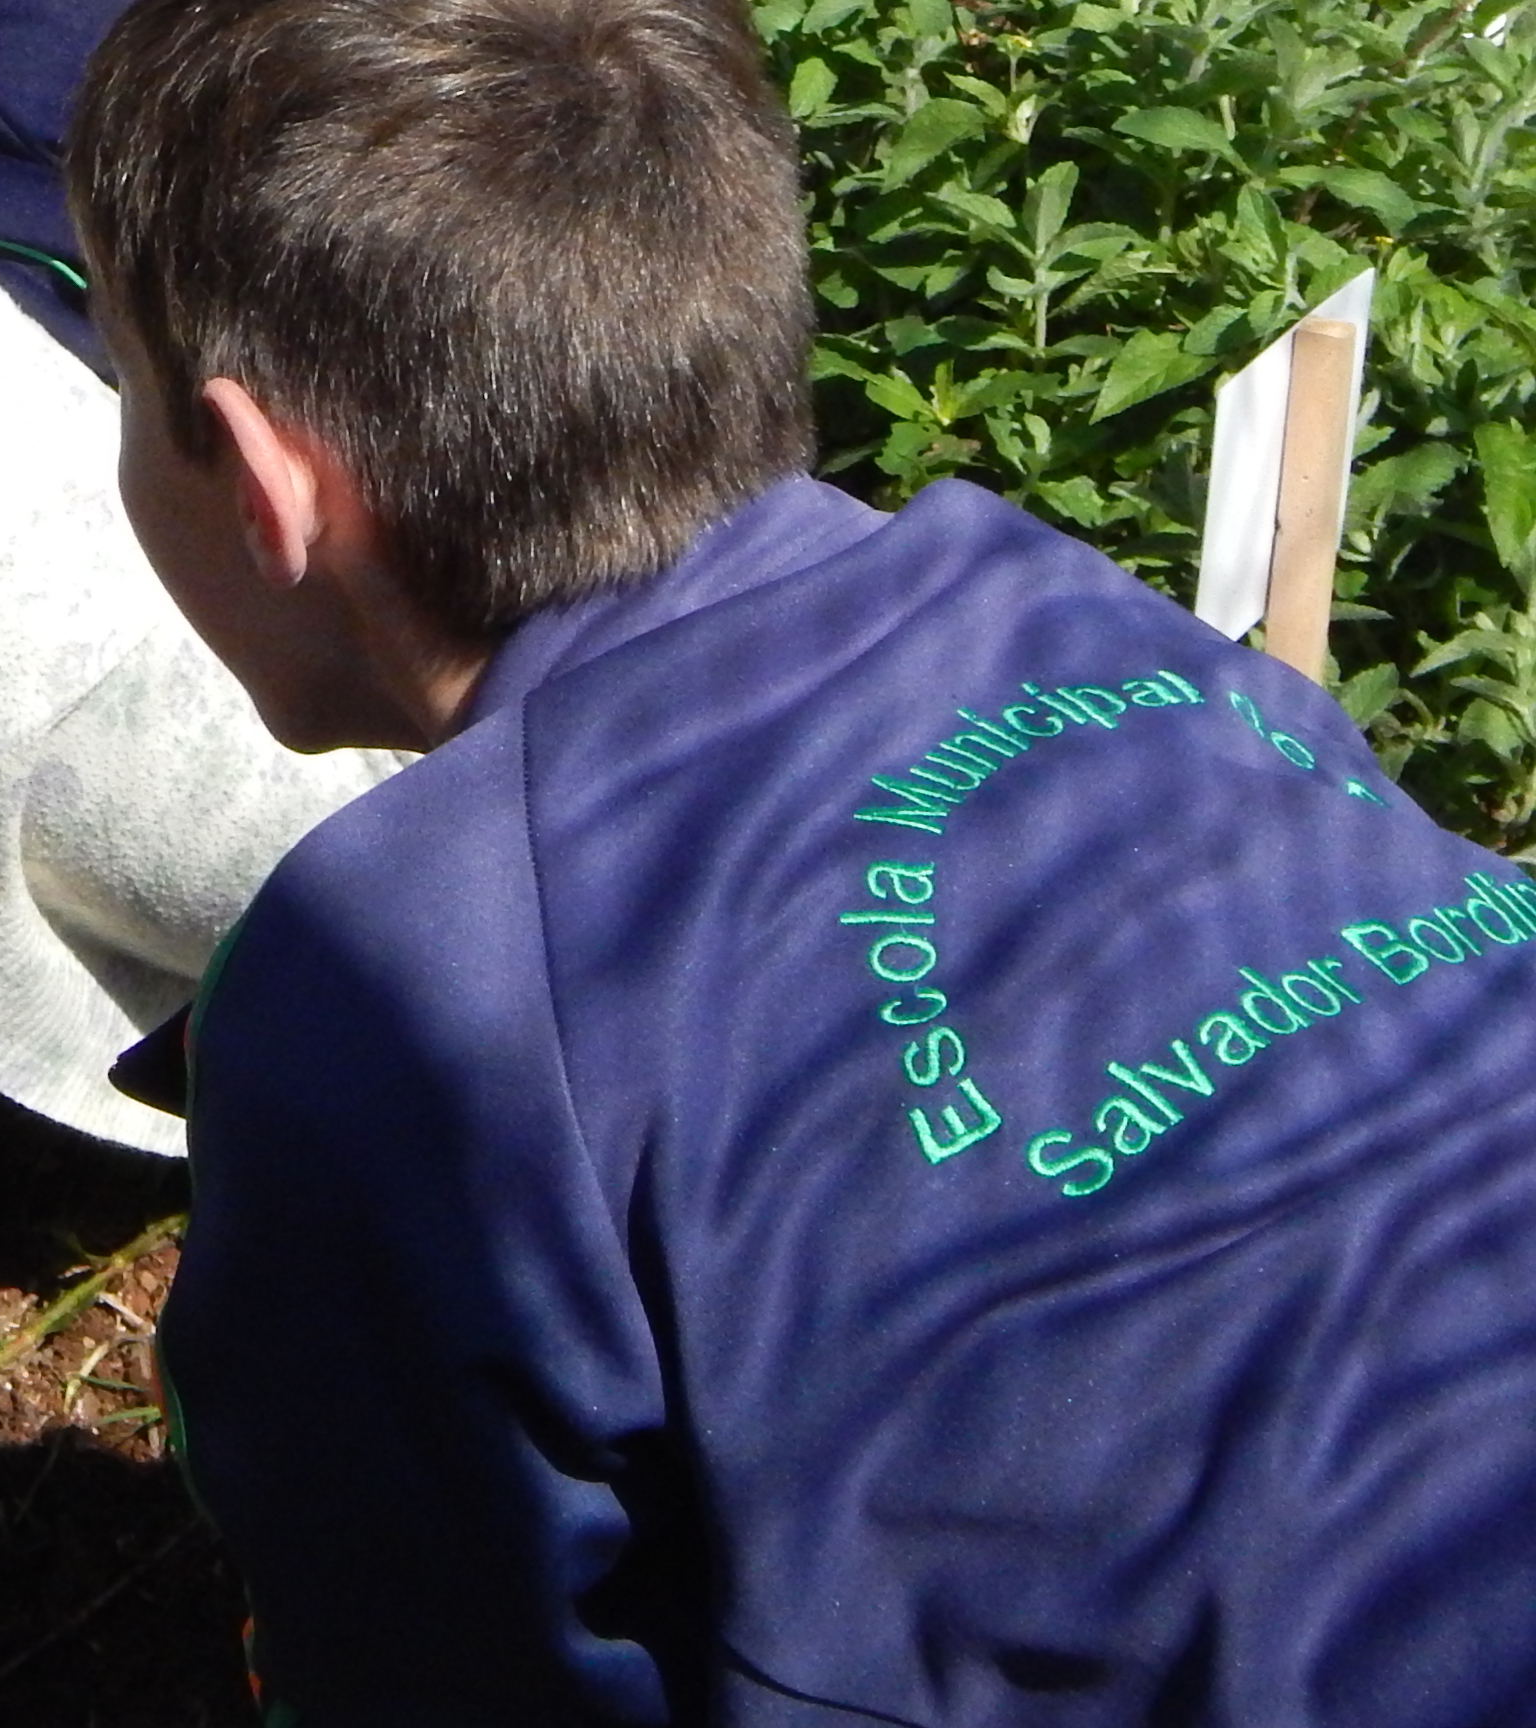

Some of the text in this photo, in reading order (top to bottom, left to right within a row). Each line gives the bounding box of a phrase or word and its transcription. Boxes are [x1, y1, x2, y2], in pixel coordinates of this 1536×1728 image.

[840, 670, 1206, 1165] Escola Municipal
[1028, 956, 1361, 1197] Salvador
